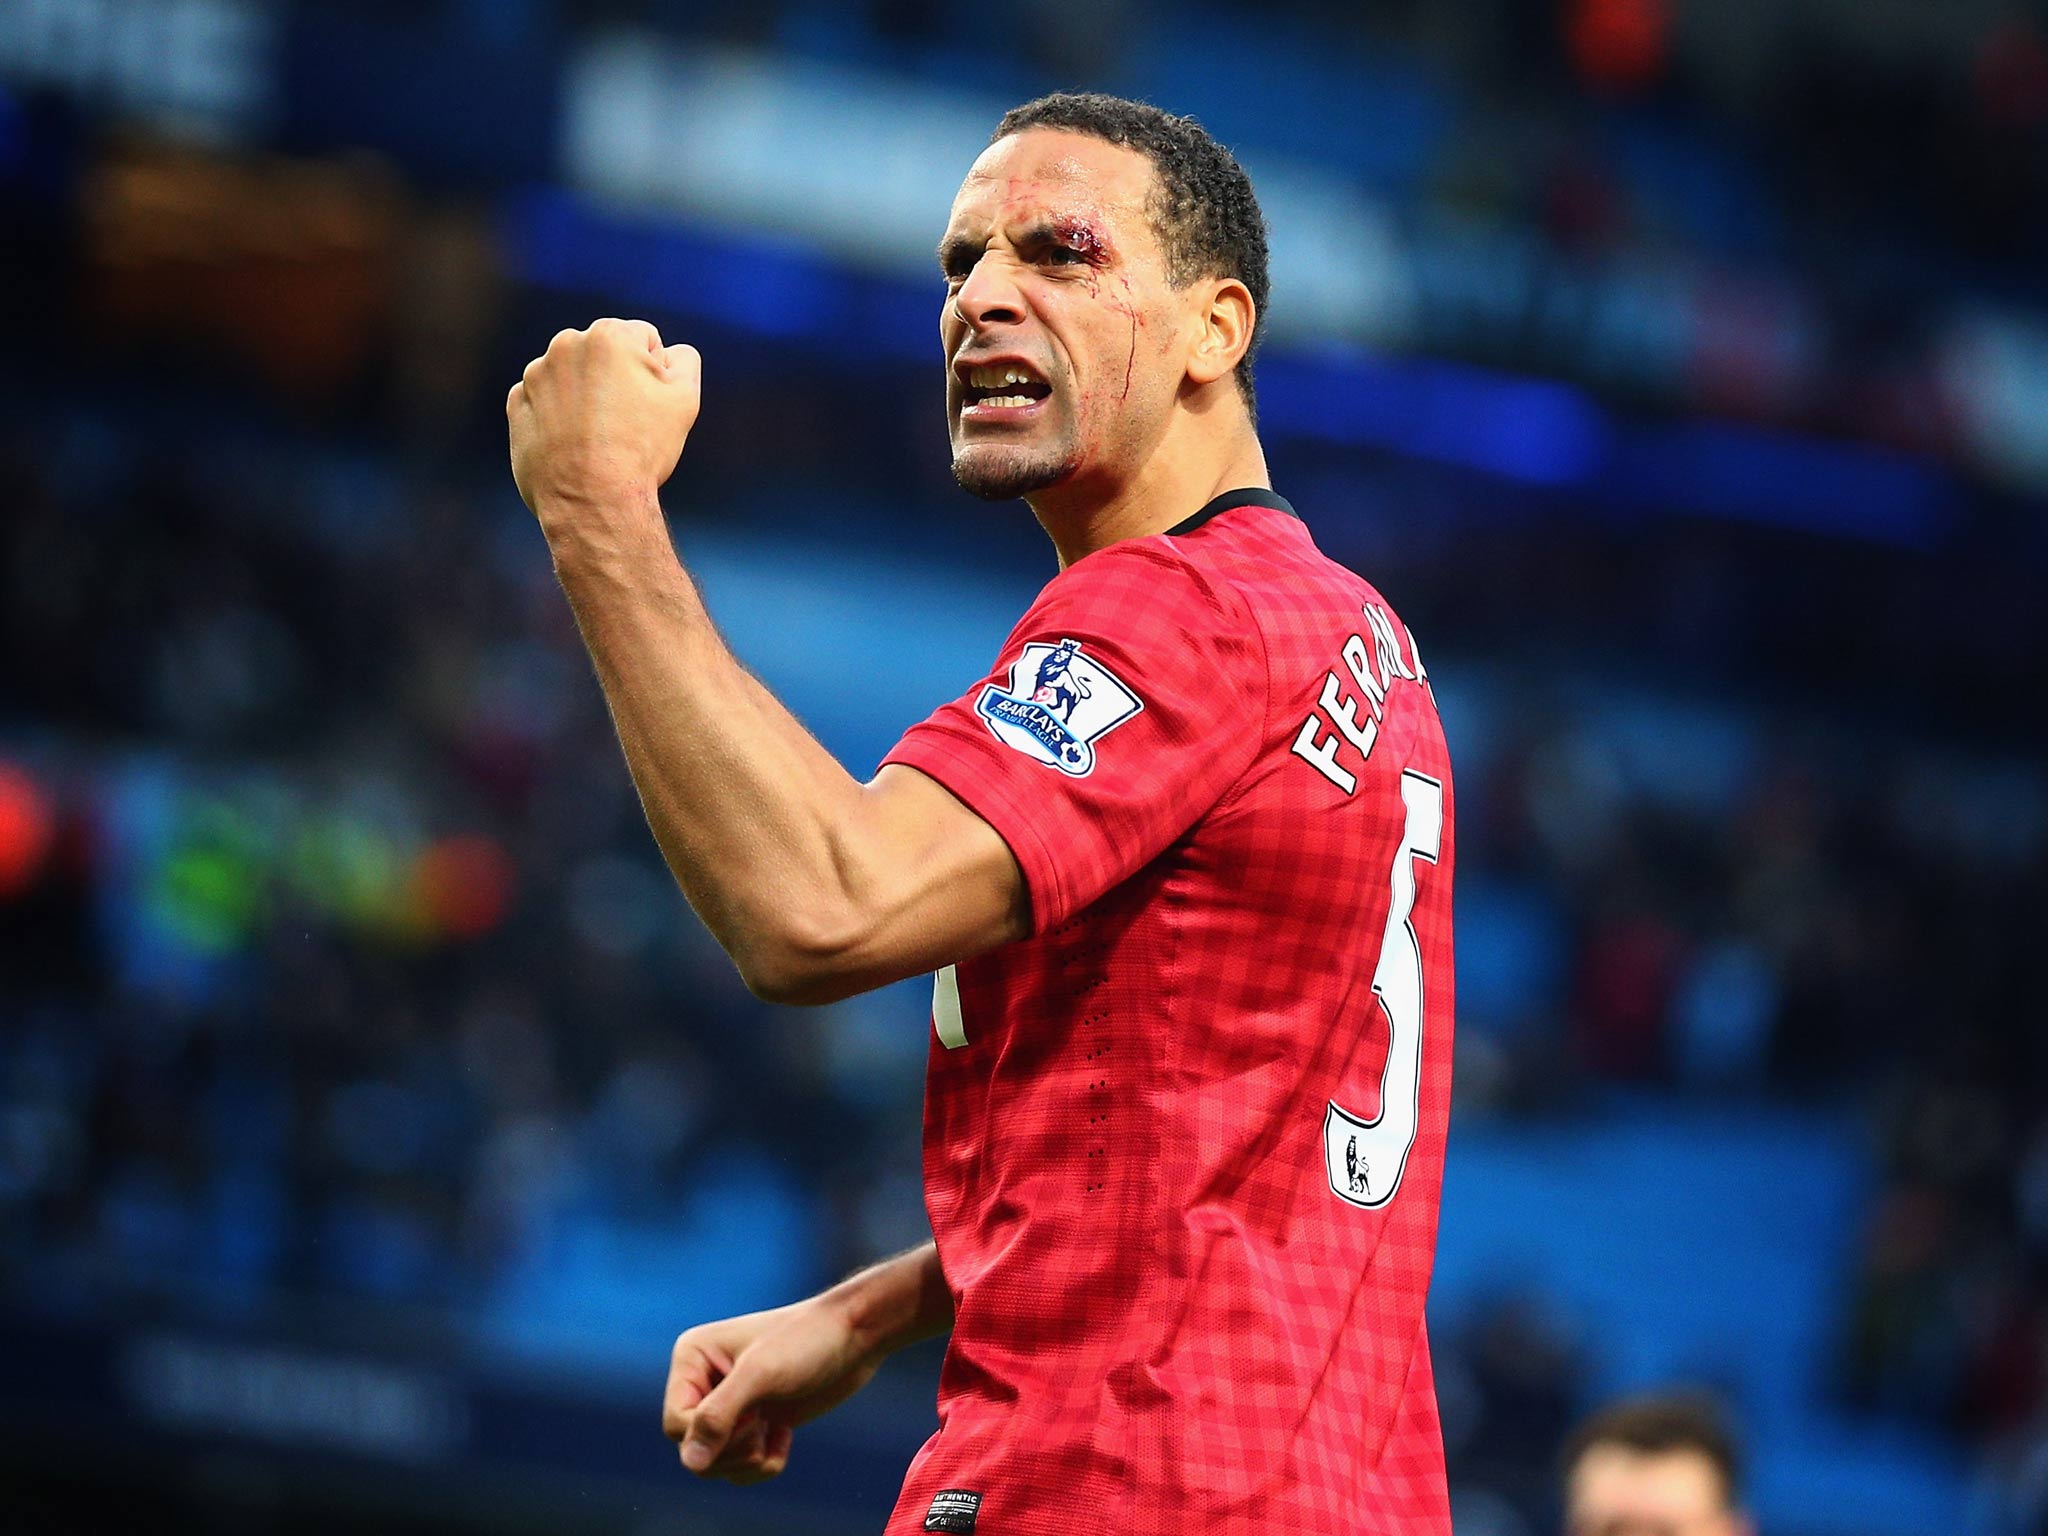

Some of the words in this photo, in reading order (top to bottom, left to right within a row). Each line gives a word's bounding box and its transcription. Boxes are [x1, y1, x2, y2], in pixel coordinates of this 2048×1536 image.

[997, 700, 1065, 742] BARCLAYS
[1023, 718, 1055, 749] LEAGUE
[1323, 768, 1442, 1211] 5
